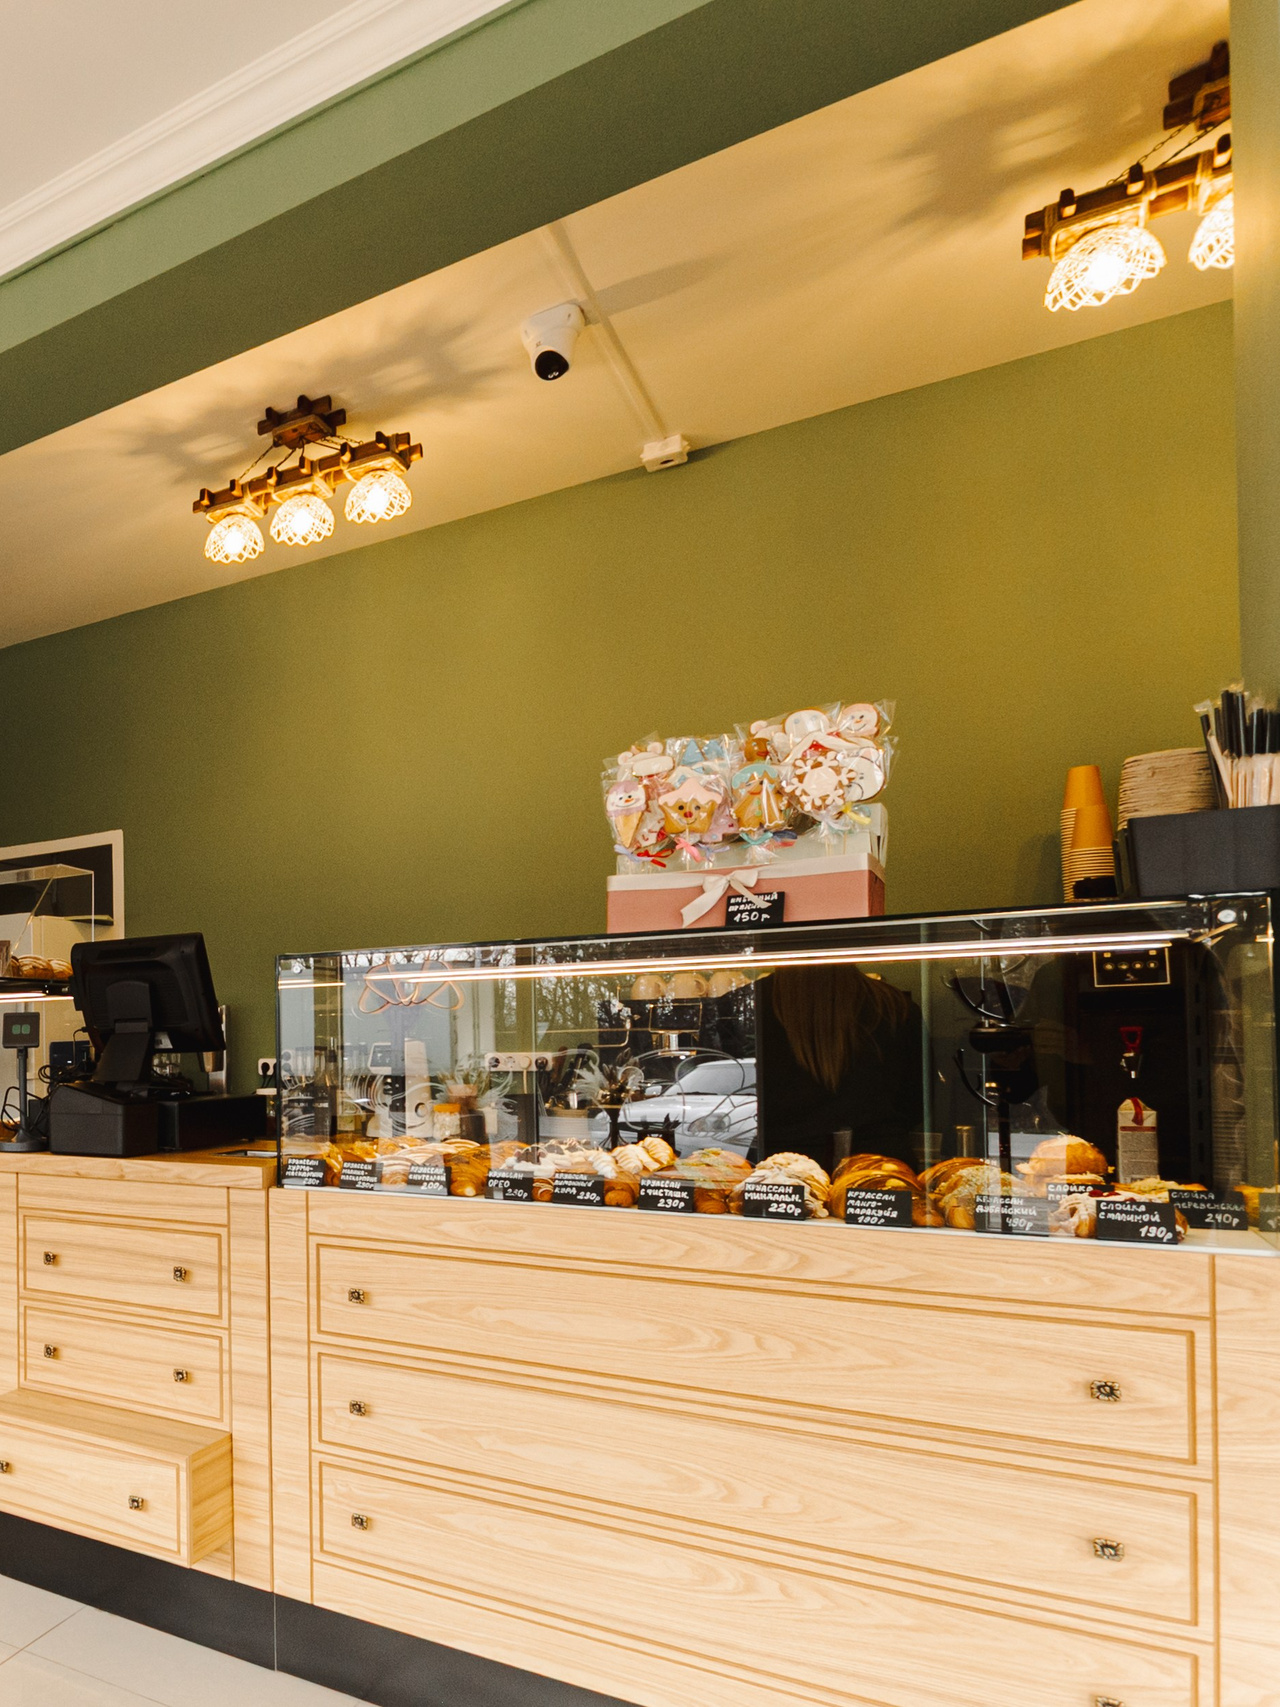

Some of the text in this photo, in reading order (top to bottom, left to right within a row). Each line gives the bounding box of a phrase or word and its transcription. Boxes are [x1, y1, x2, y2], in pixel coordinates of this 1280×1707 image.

[488, 1170, 524, 1180] КРУАССАН
[641, 1179, 681, 1188] КРУАССАН
[746, 1183, 793, 1193] КРУАССАН
[577, 1192, 600, 1203] 230р
[847, 1191, 895, 1201] КРУАССАН
[976, 1196, 1023, 1205] КРУАССАН
[1171, 1191, 1215, 1200] СЛОЙКА
[657, 1199, 685, 1209] 230р
[1100, 1201, 1146, 1212] СЛОЙКА
[768, 1203, 801, 1216] 220р
[847, 1207, 898, 1217] МАРАКУЙЯ
[975, 1205, 1037, 1216] ДУБАЙСКИЙ
[1107, 1211, 1161, 1223] МАЛИНОЙ
[1205, 1213, 1240, 1227] 240р
[1006, 1217, 1033, 1231] 490р
[1139, 1225, 1173, 1242] 190р
